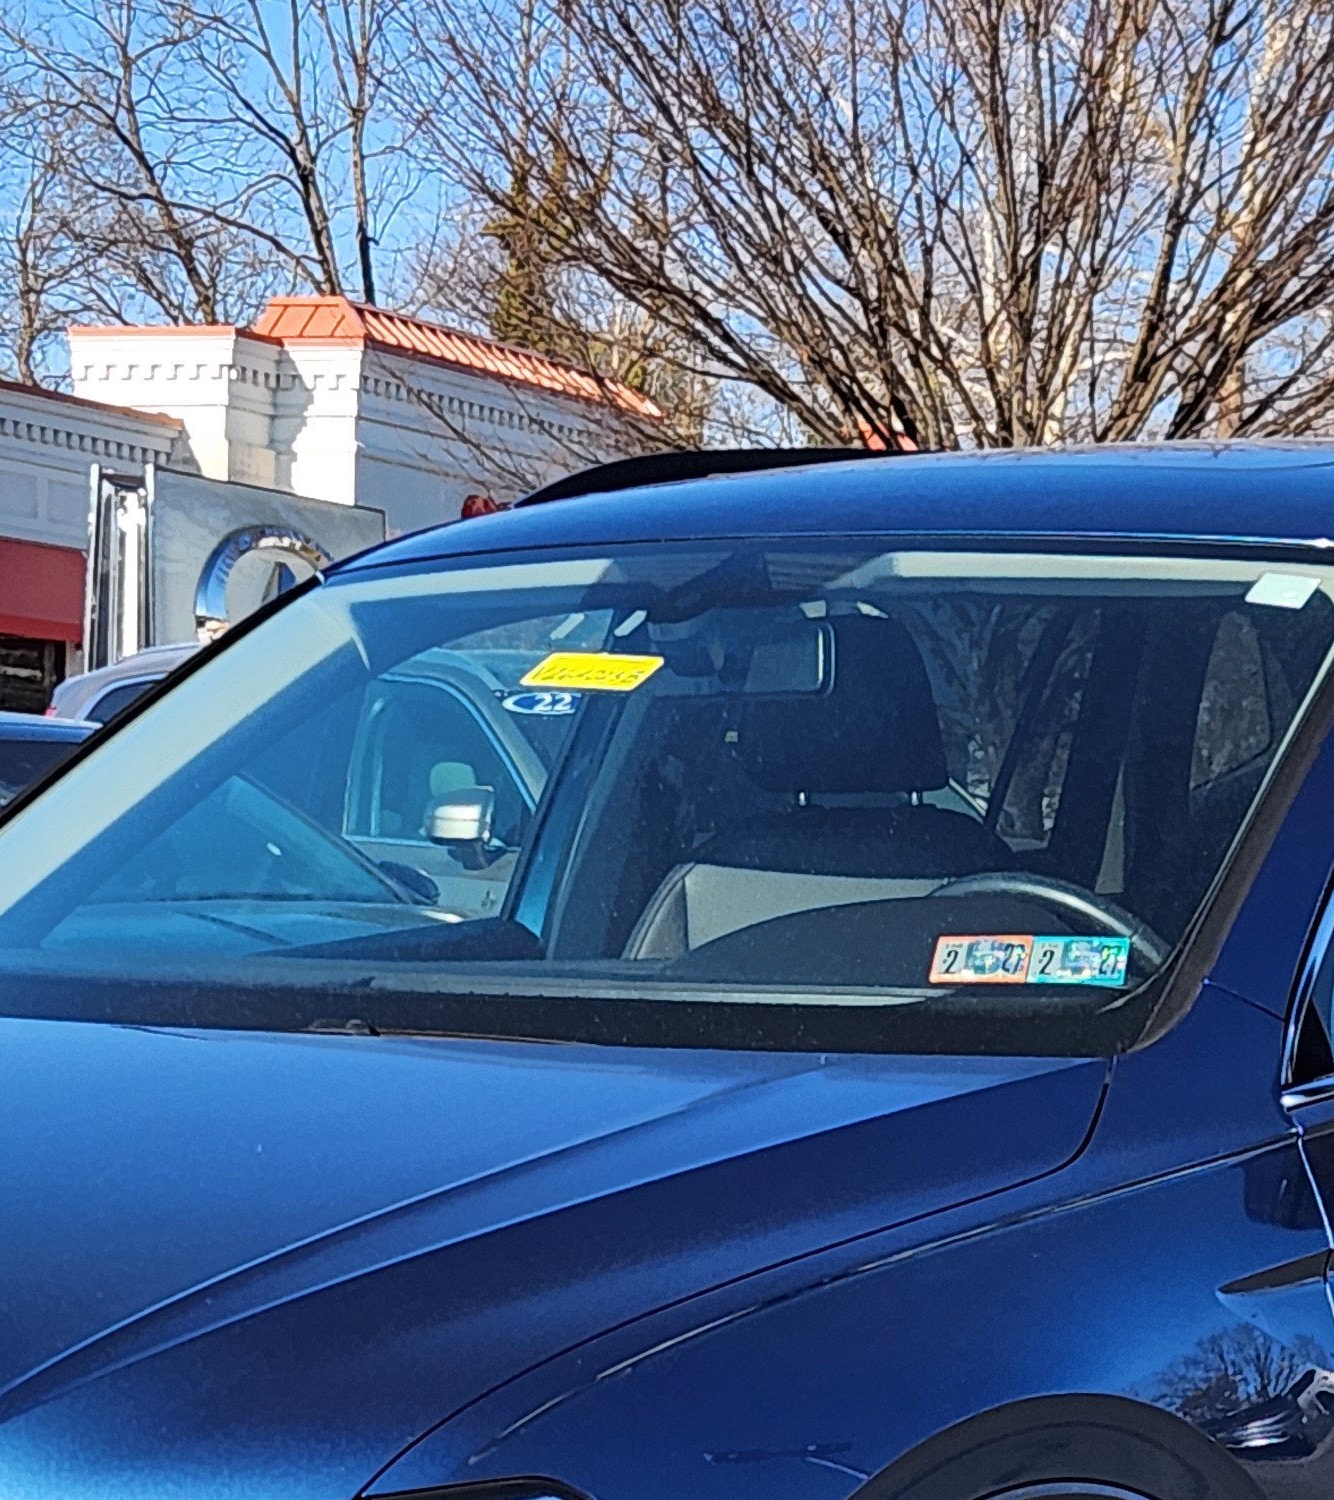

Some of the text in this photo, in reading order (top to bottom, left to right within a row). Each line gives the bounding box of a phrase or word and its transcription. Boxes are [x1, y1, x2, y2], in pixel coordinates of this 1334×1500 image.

[534, 693, 573, 711] 22
[943, 949, 959, 975] 2
[1038, 949, 1055, 975] 2
